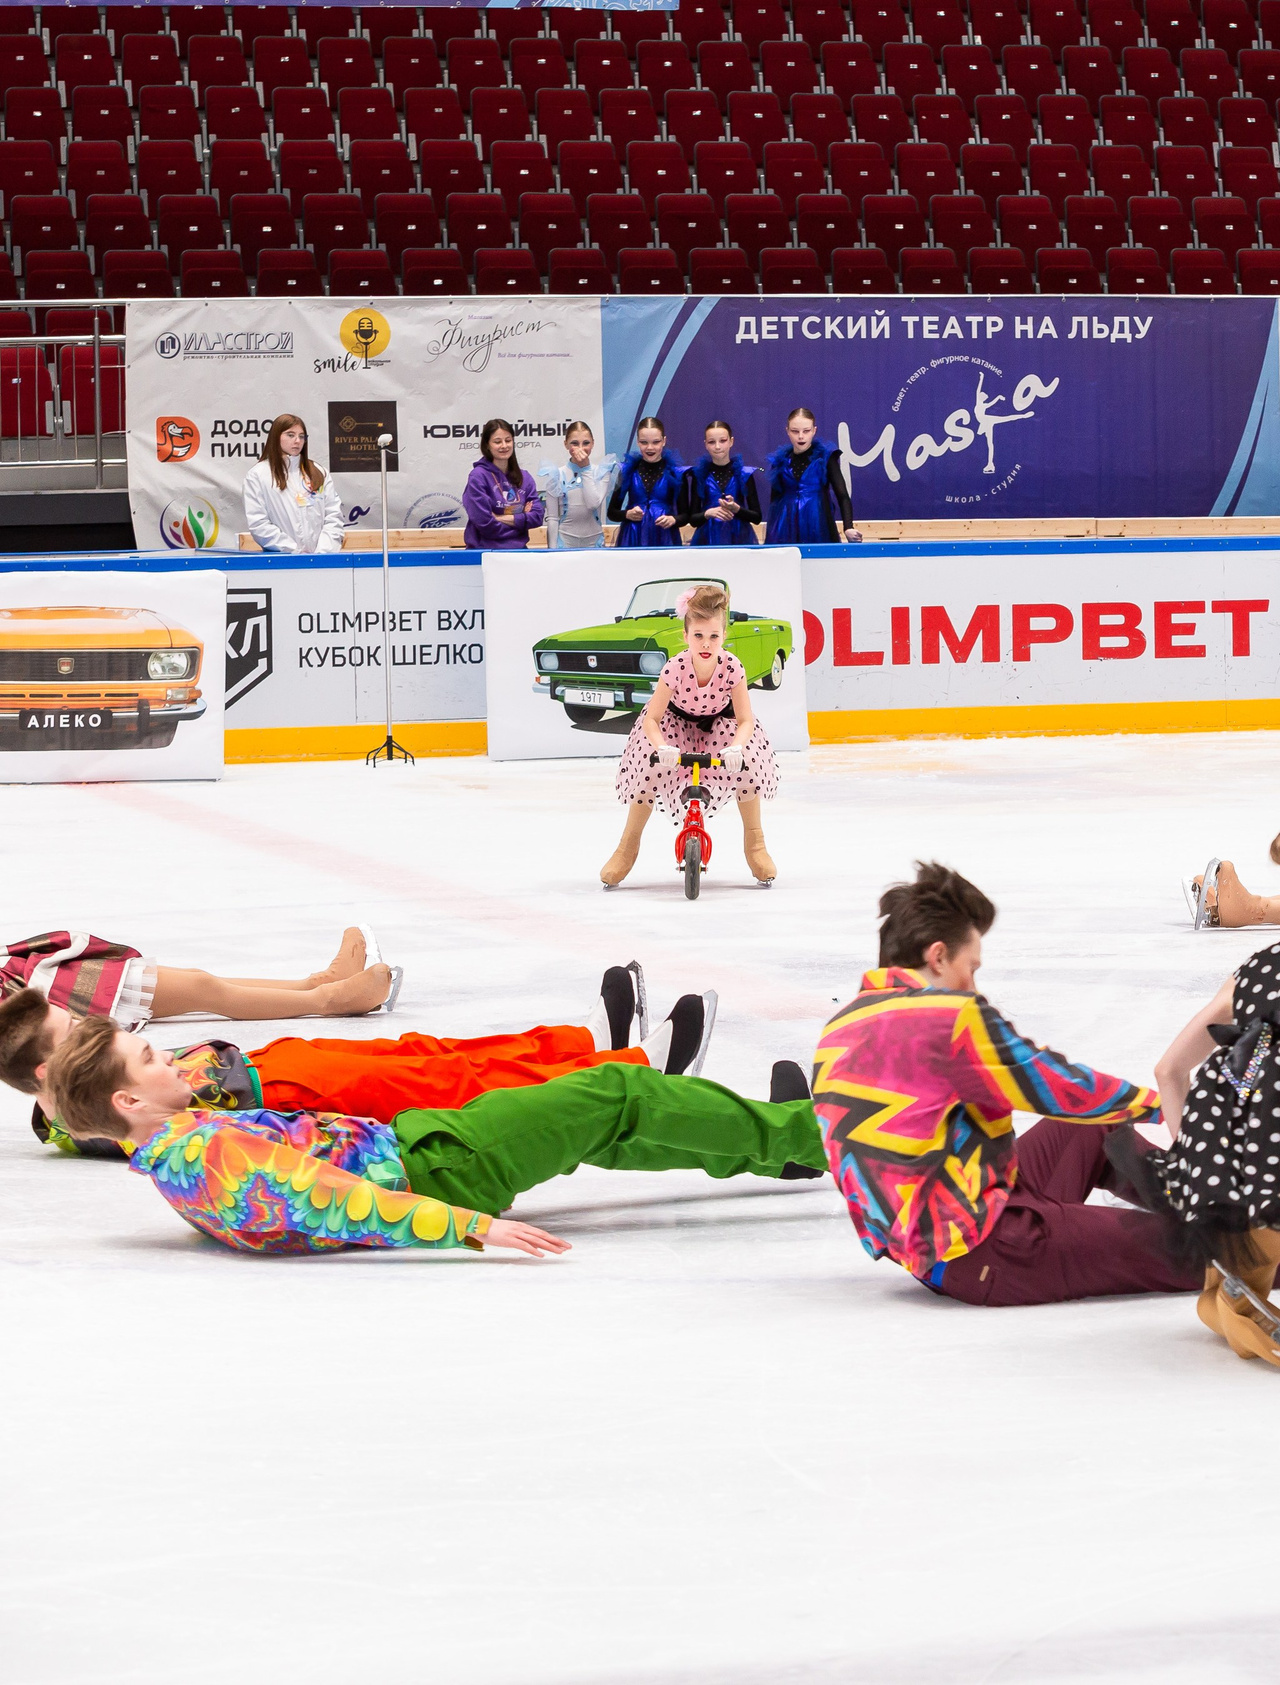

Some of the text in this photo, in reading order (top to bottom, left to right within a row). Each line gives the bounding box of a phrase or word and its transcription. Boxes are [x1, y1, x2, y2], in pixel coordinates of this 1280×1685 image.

[735, 310, 1154, 344] ДЕТСКИЙ ТЕАТР НА ЛЬДУ
[183, 331, 294, 351] ИЛАССТРОЙ
[313, 350, 361, 374] smile
[929, 355, 970, 369] фигурное
[211, 419, 274, 438] ДОДО
[211, 442, 264, 460] ПИЦ
[945, 494, 981, 503] школа
[991, 463, 1021, 495] студия
[298, 609, 485, 634] OLIMPBET ВХЛ
[803, 599, 1270, 667] LIMPBET
[299, 643, 484, 668] КУБОК ШЕЛКО
[580, 691, 602, 704] 1977
[27, 713, 102, 729] АЛЕКО
